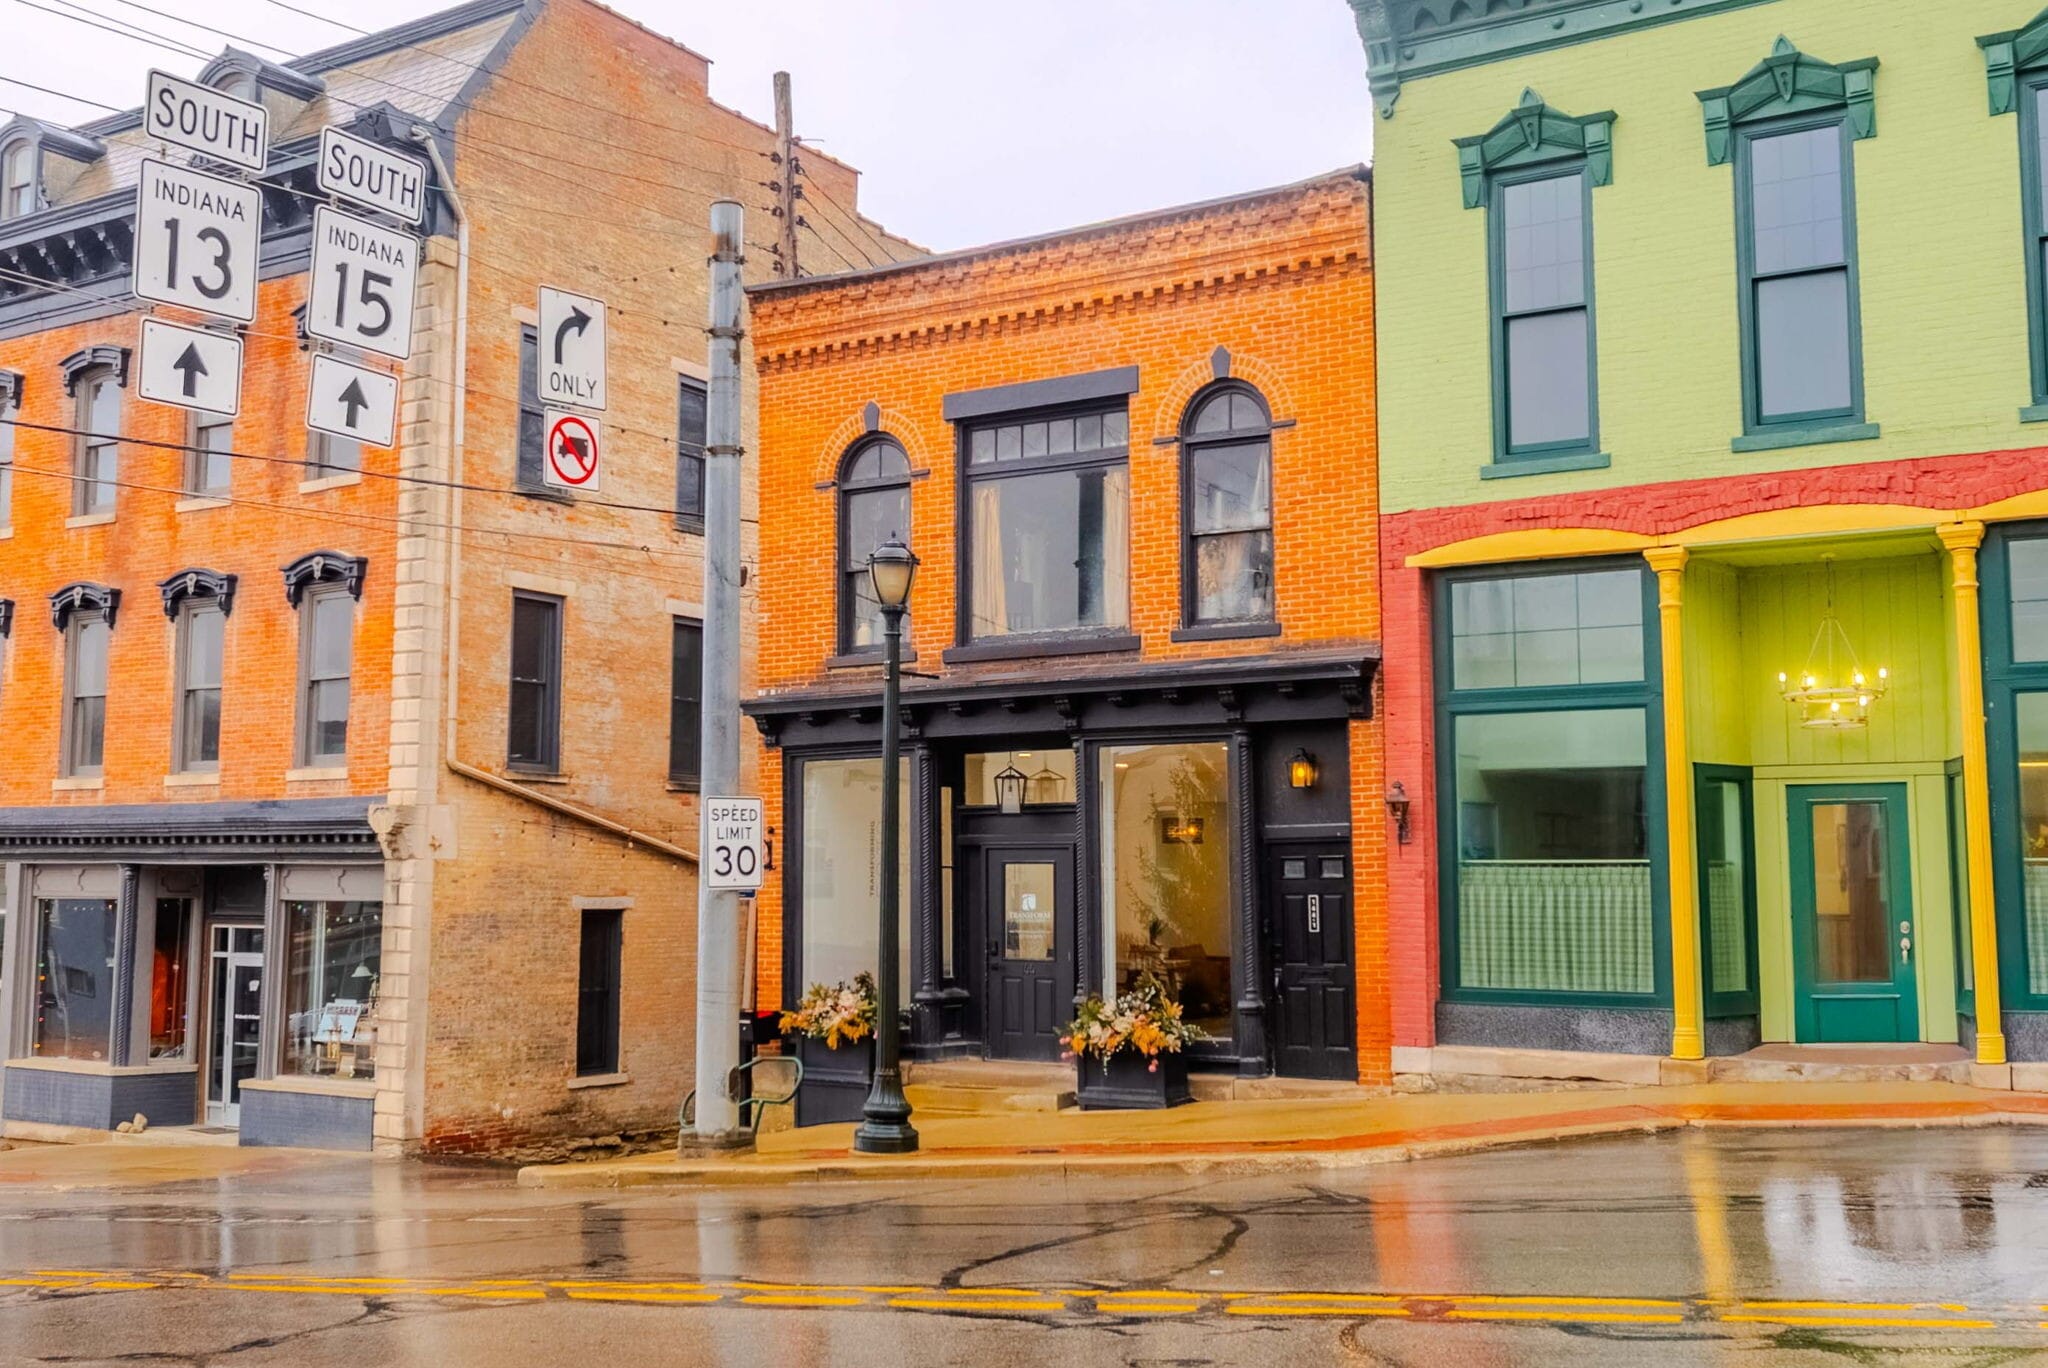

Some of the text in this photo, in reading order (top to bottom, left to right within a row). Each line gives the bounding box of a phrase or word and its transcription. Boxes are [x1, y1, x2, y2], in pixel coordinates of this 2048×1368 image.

[155, 87, 260, 157] SOUTH
[328, 144, 417, 210] SOUTH
[155, 178, 246, 222] INDIANA
[164, 217, 233, 300] 13
[328, 225, 405, 269] INDIANA
[335, 262, 393, 338] 15
[550, 371, 597, 398] ONLY
[711, 808, 758, 822] SPEED
[716, 826, 753, 840] LIMIT
[714, 845, 756, 876] 30
[1009, 911, 1051, 920] TRANSFORM
